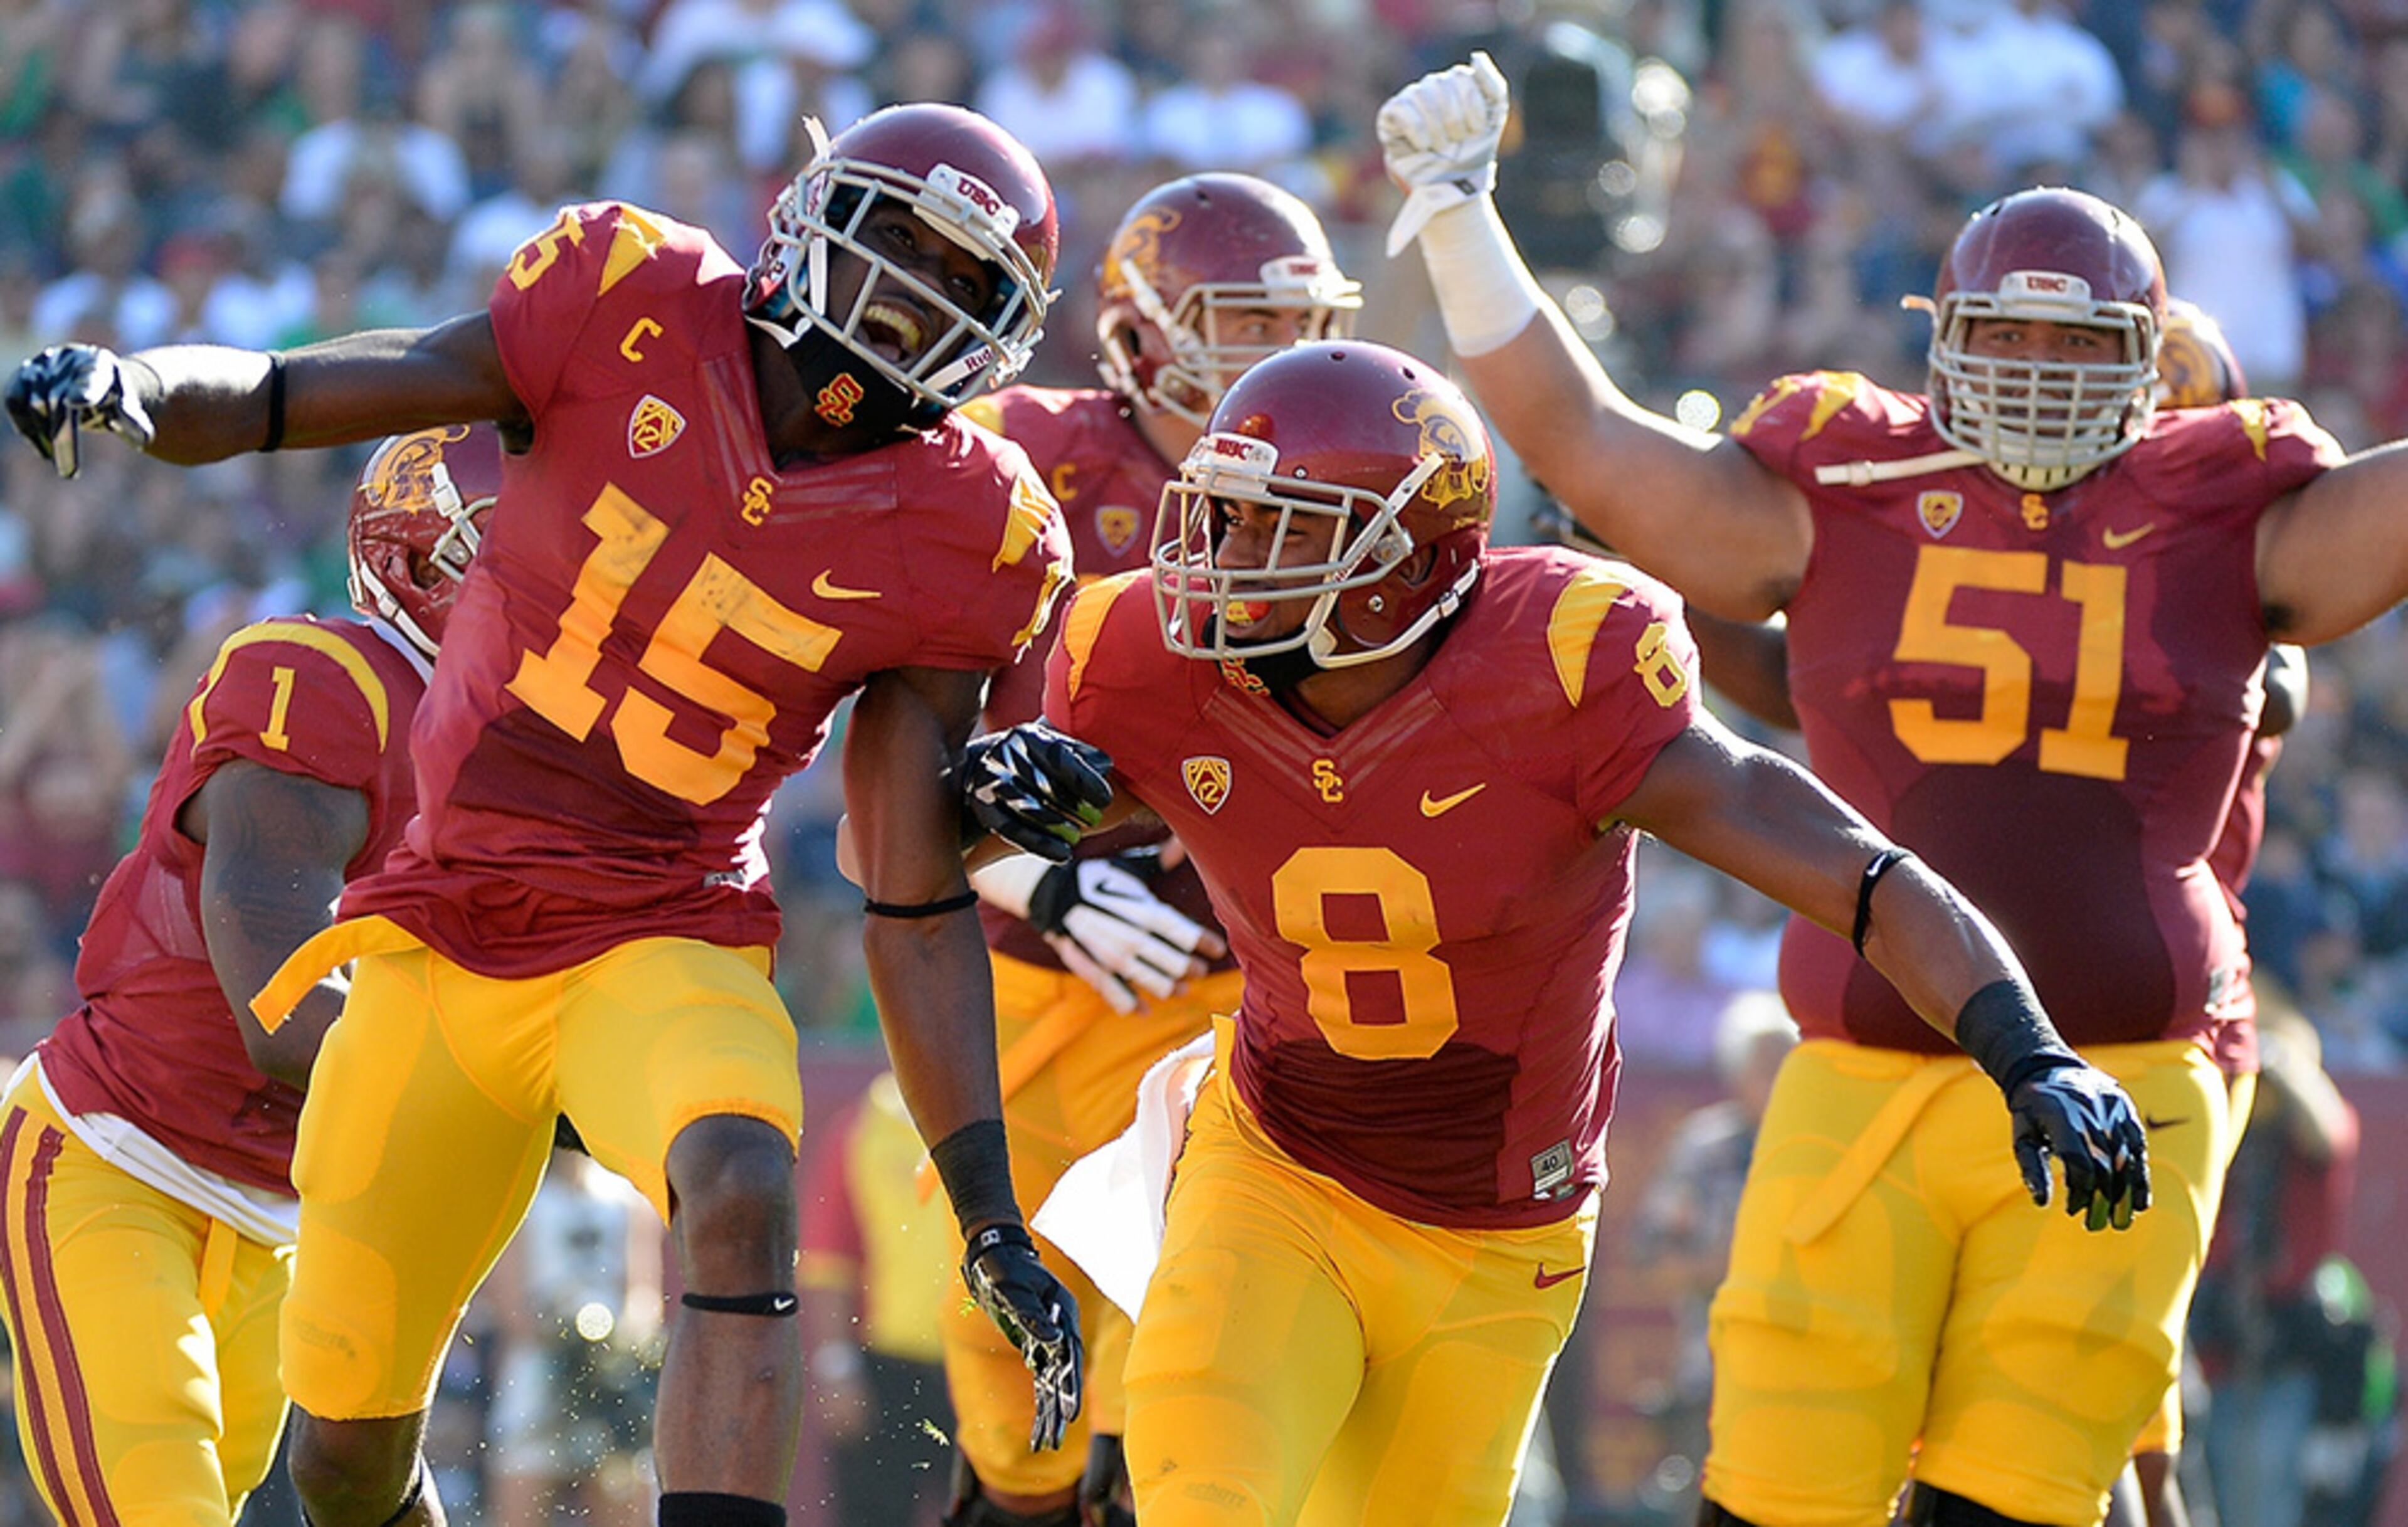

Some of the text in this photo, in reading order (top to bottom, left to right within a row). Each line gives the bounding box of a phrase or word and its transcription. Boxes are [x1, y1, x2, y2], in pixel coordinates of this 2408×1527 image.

[619, 317, 663, 362] C
[741, 477, 773, 526] SC
[1052, 463, 1078, 501] C
[504, 480, 843, 807] 15
[1634, 621, 1687, 708] 8
[1888, 544, 2130, 782] 51
[260, 667, 296, 752] 1
[1312, 759, 1343, 802] SC
[1272, 847, 1459, 1060] 8
